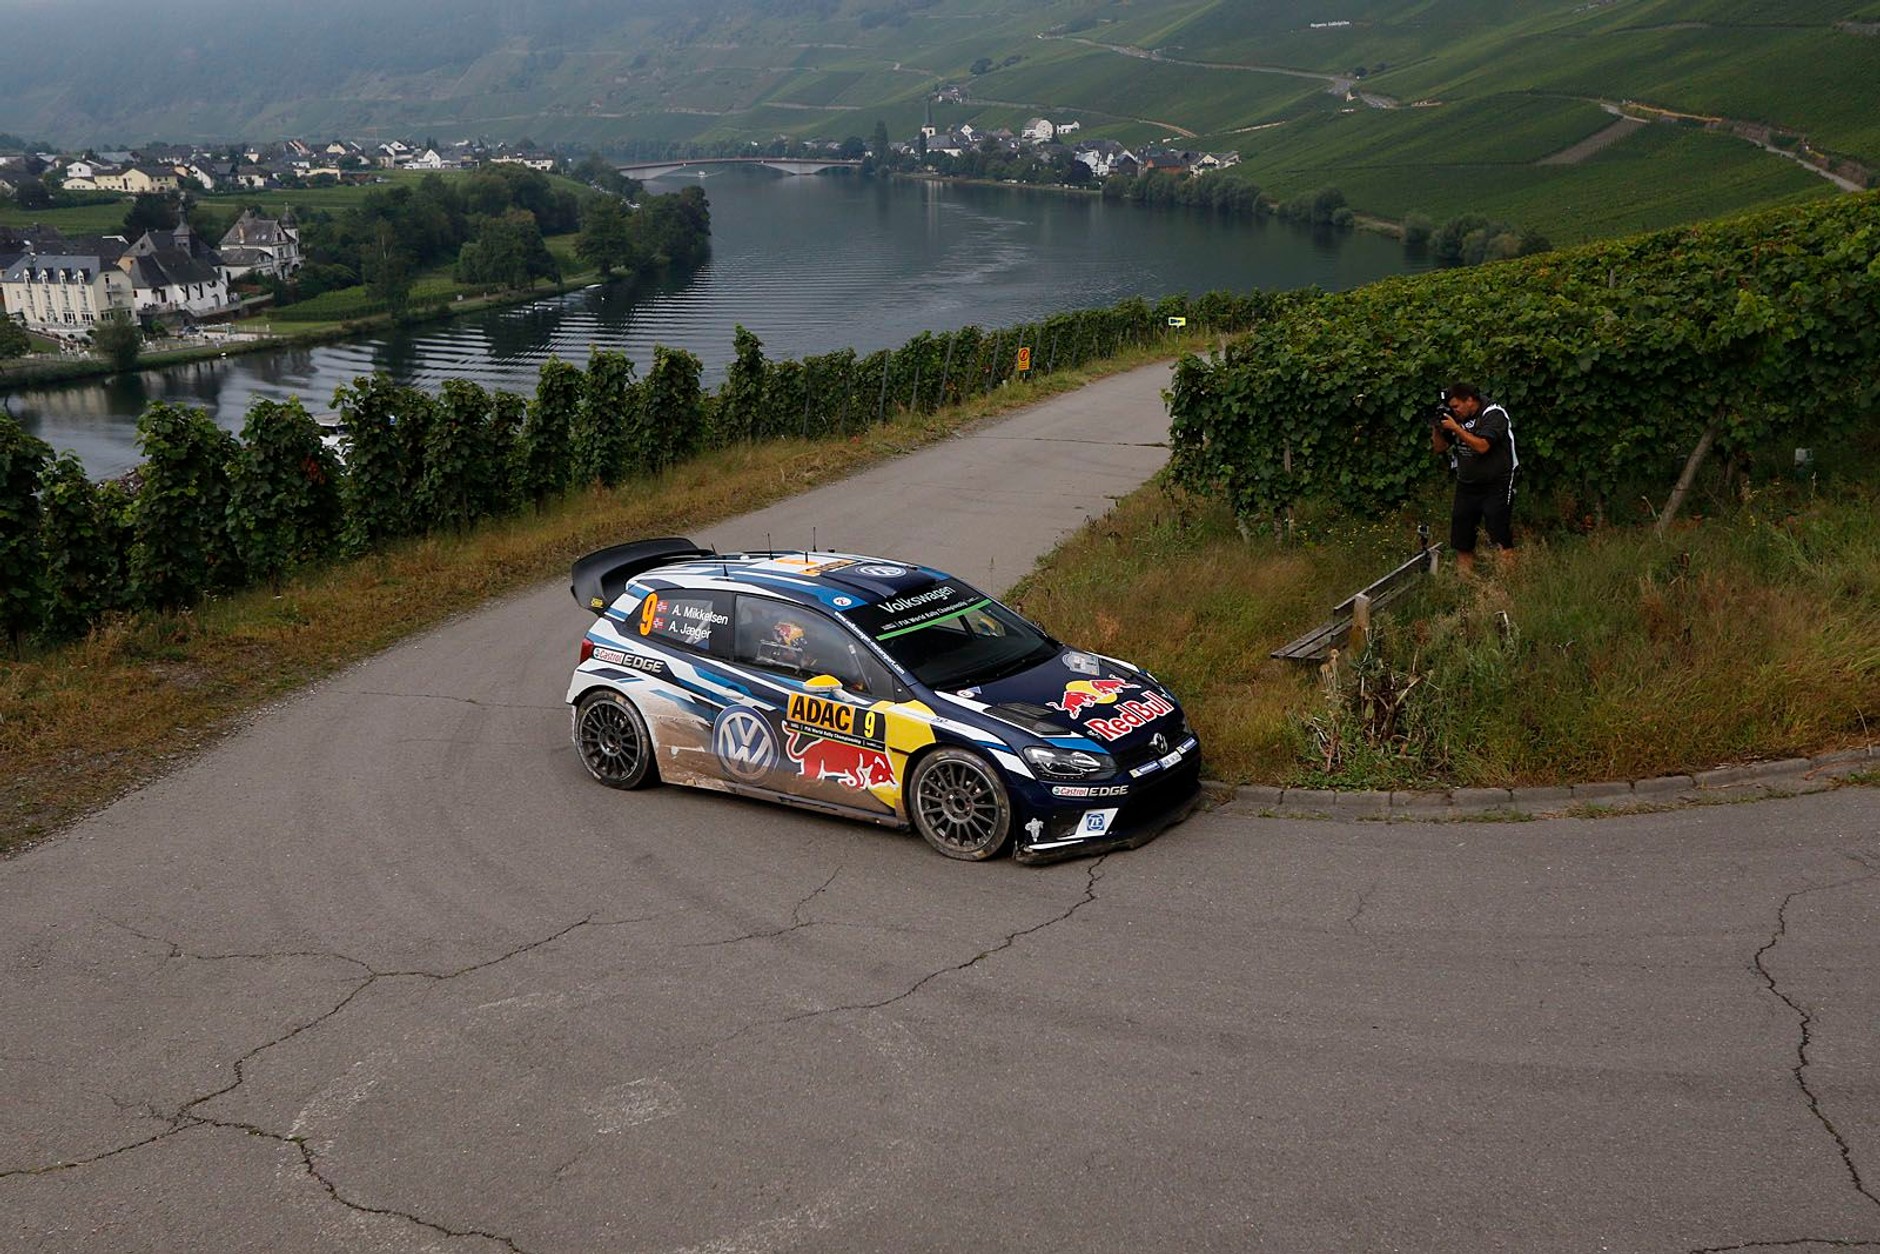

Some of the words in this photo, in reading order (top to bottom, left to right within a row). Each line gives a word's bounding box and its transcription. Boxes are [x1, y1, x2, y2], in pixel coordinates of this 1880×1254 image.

[877, 586, 957, 614] Volkswagen
[639, 592, 659, 636] 9
[672, 604, 682, 617] A.
[683, 606, 729, 626] Mikkelsen
[668, 620, 678, 633] A.
[680, 625, 712, 640] Jæger
[600, 650, 623, 664] Castrol
[623, 656, 664, 673] EDGE
[791, 695, 850, 731] ADAC
[864, 711, 876, 738] 9
[1060, 786, 1087, 797] Castrol
[1088, 785, 1129, 797] EDGE
[1089, 815, 1104, 828] ZF
